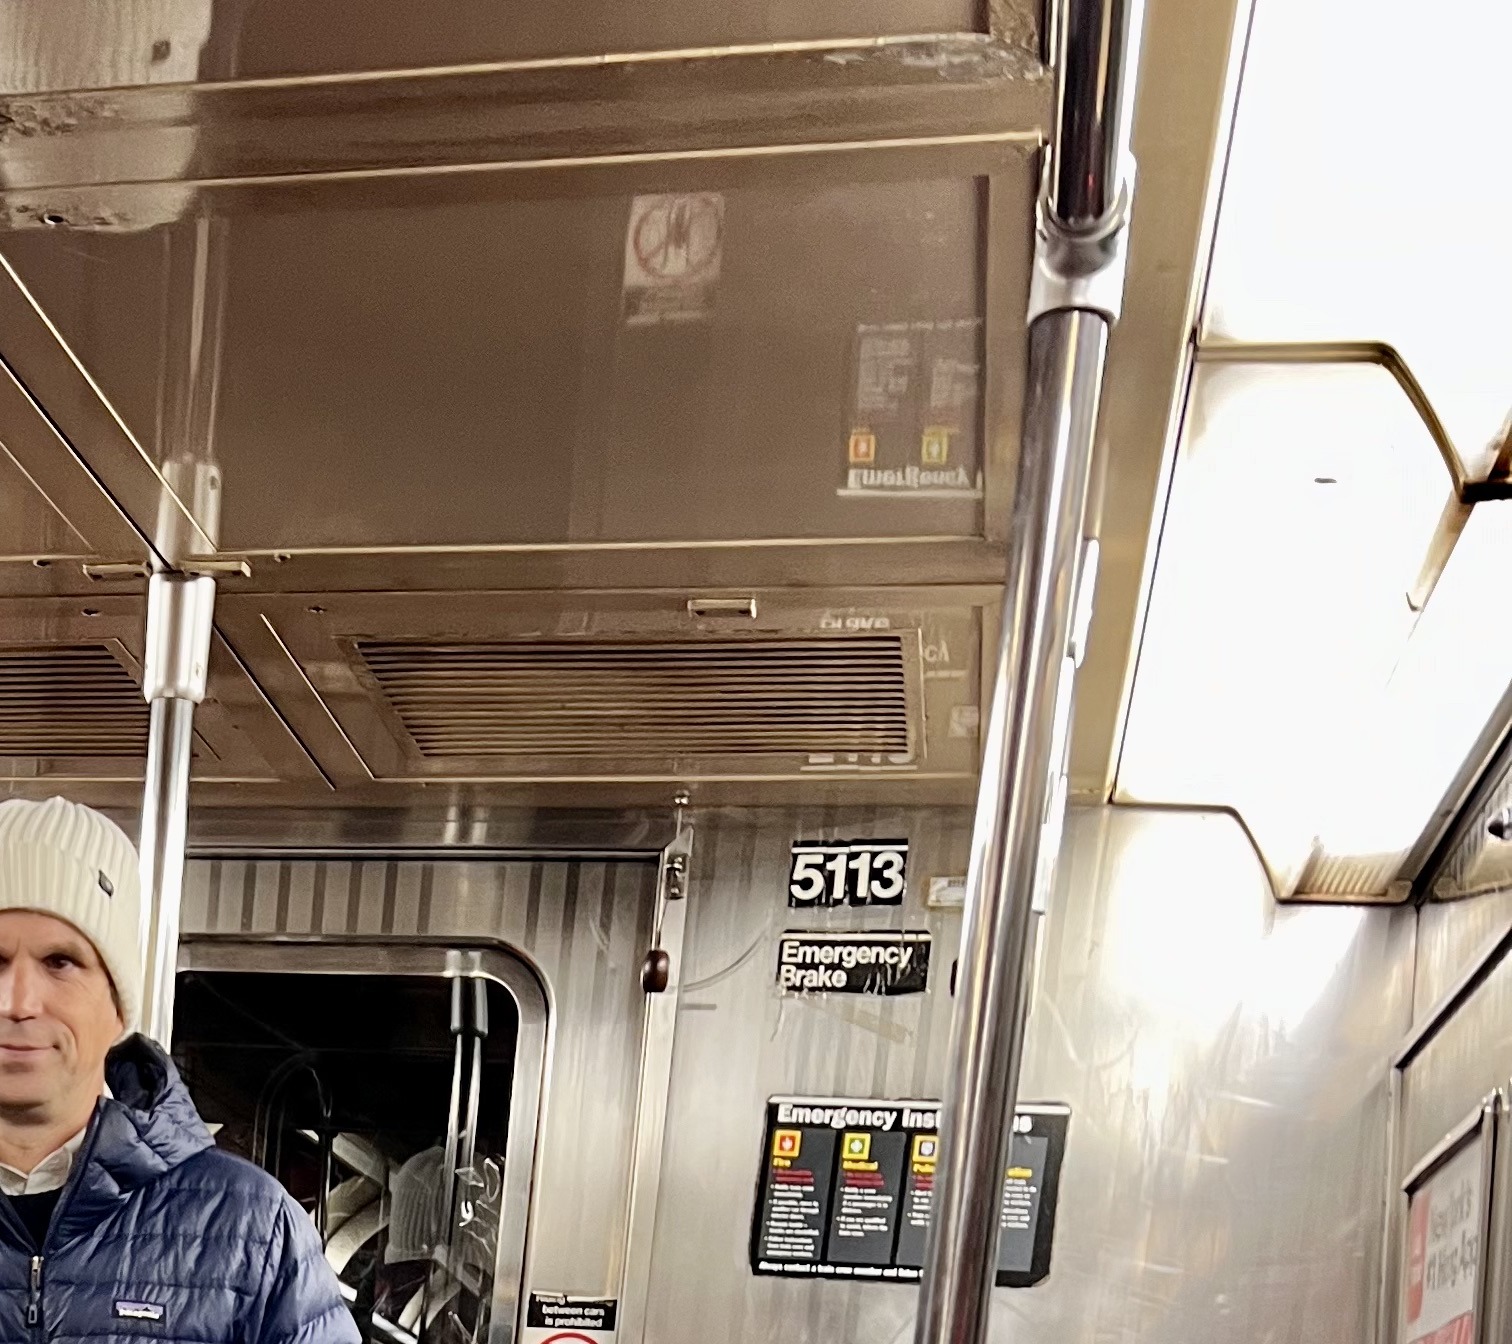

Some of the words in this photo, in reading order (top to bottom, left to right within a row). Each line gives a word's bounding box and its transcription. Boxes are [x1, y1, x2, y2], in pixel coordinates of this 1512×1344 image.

[790, 851, 904, 900] 5113
[781, 940, 913, 969] Emergency
[780, 964, 848, 988] Brake
[777, 1103, 898, 1131] Emergency
[542, 1304, 583, 1315] between
[584, 1308, 605, 1316] cars
[545, 1316, 553, 1325] is
[555, 1317, 602, 1327] prohibited
